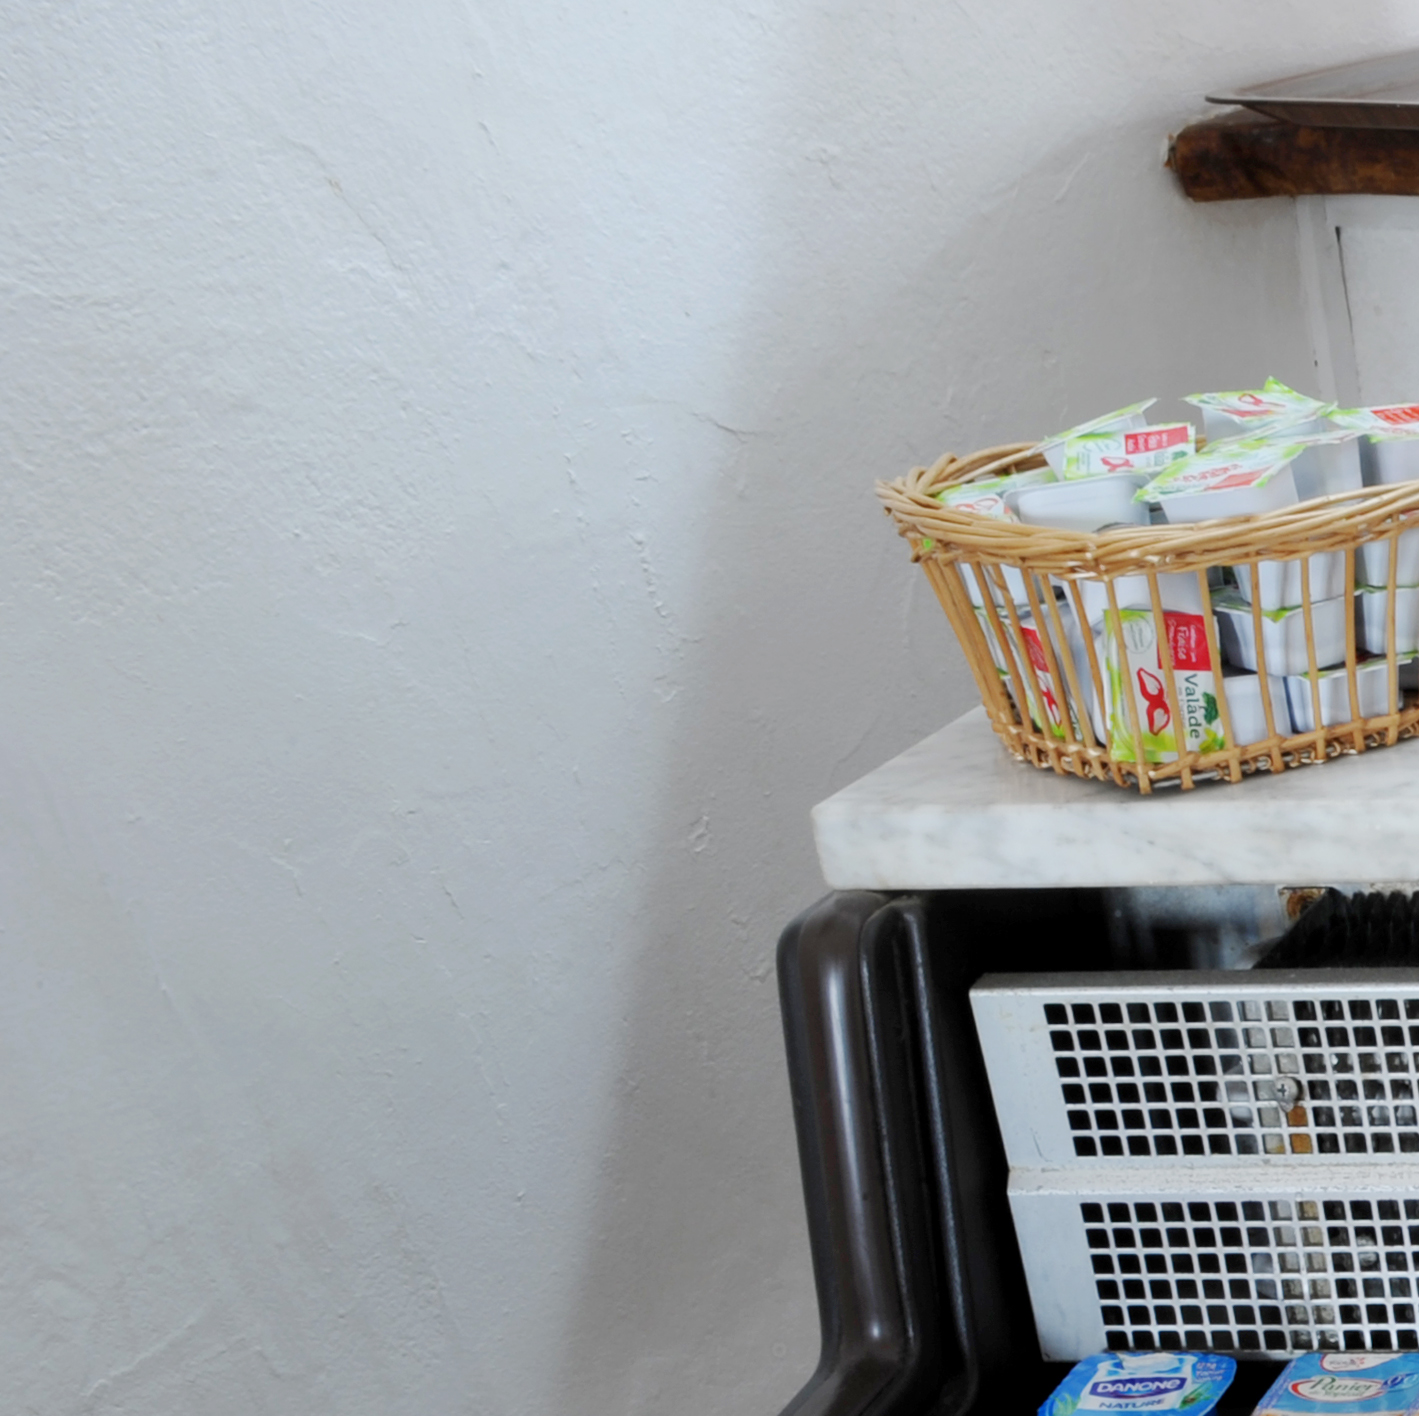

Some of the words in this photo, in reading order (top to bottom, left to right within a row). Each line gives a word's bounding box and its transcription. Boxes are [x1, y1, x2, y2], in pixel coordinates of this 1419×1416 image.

[1184, 673, 1203, 740] Valade
[1096, 1379, 1182, 1394] DANONE
[1310, 1376, 1377, 1391] Panier
[1099, 1399, 1166, 1410] NATURE
